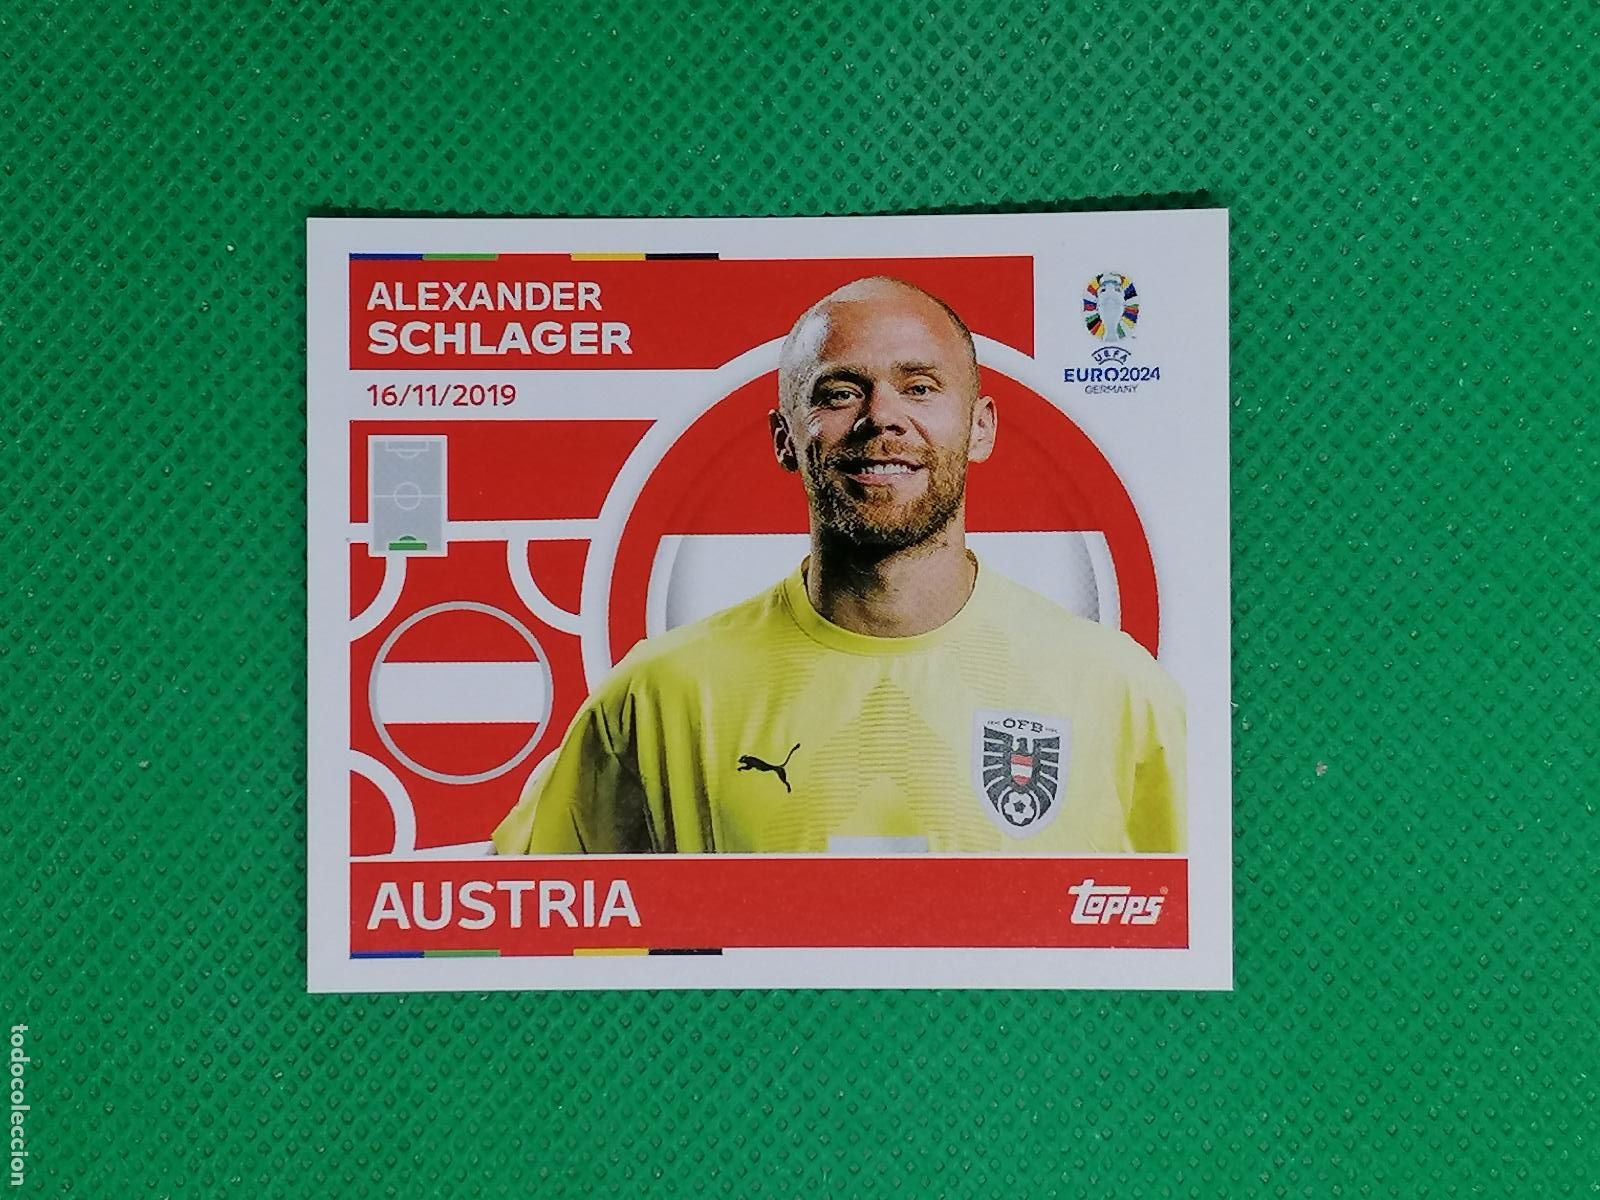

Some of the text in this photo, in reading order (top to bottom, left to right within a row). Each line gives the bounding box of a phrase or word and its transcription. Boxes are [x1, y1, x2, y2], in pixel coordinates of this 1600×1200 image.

[366, 281, 603, 312] ALEXANDER
[367, 320, 634, 356] SCHLAGER
[1094, 350, 1128, 362] UEFA
[366, 383, 517, 407] 16/11/2019
[366, 879, 642, 931] AUSTRIA
